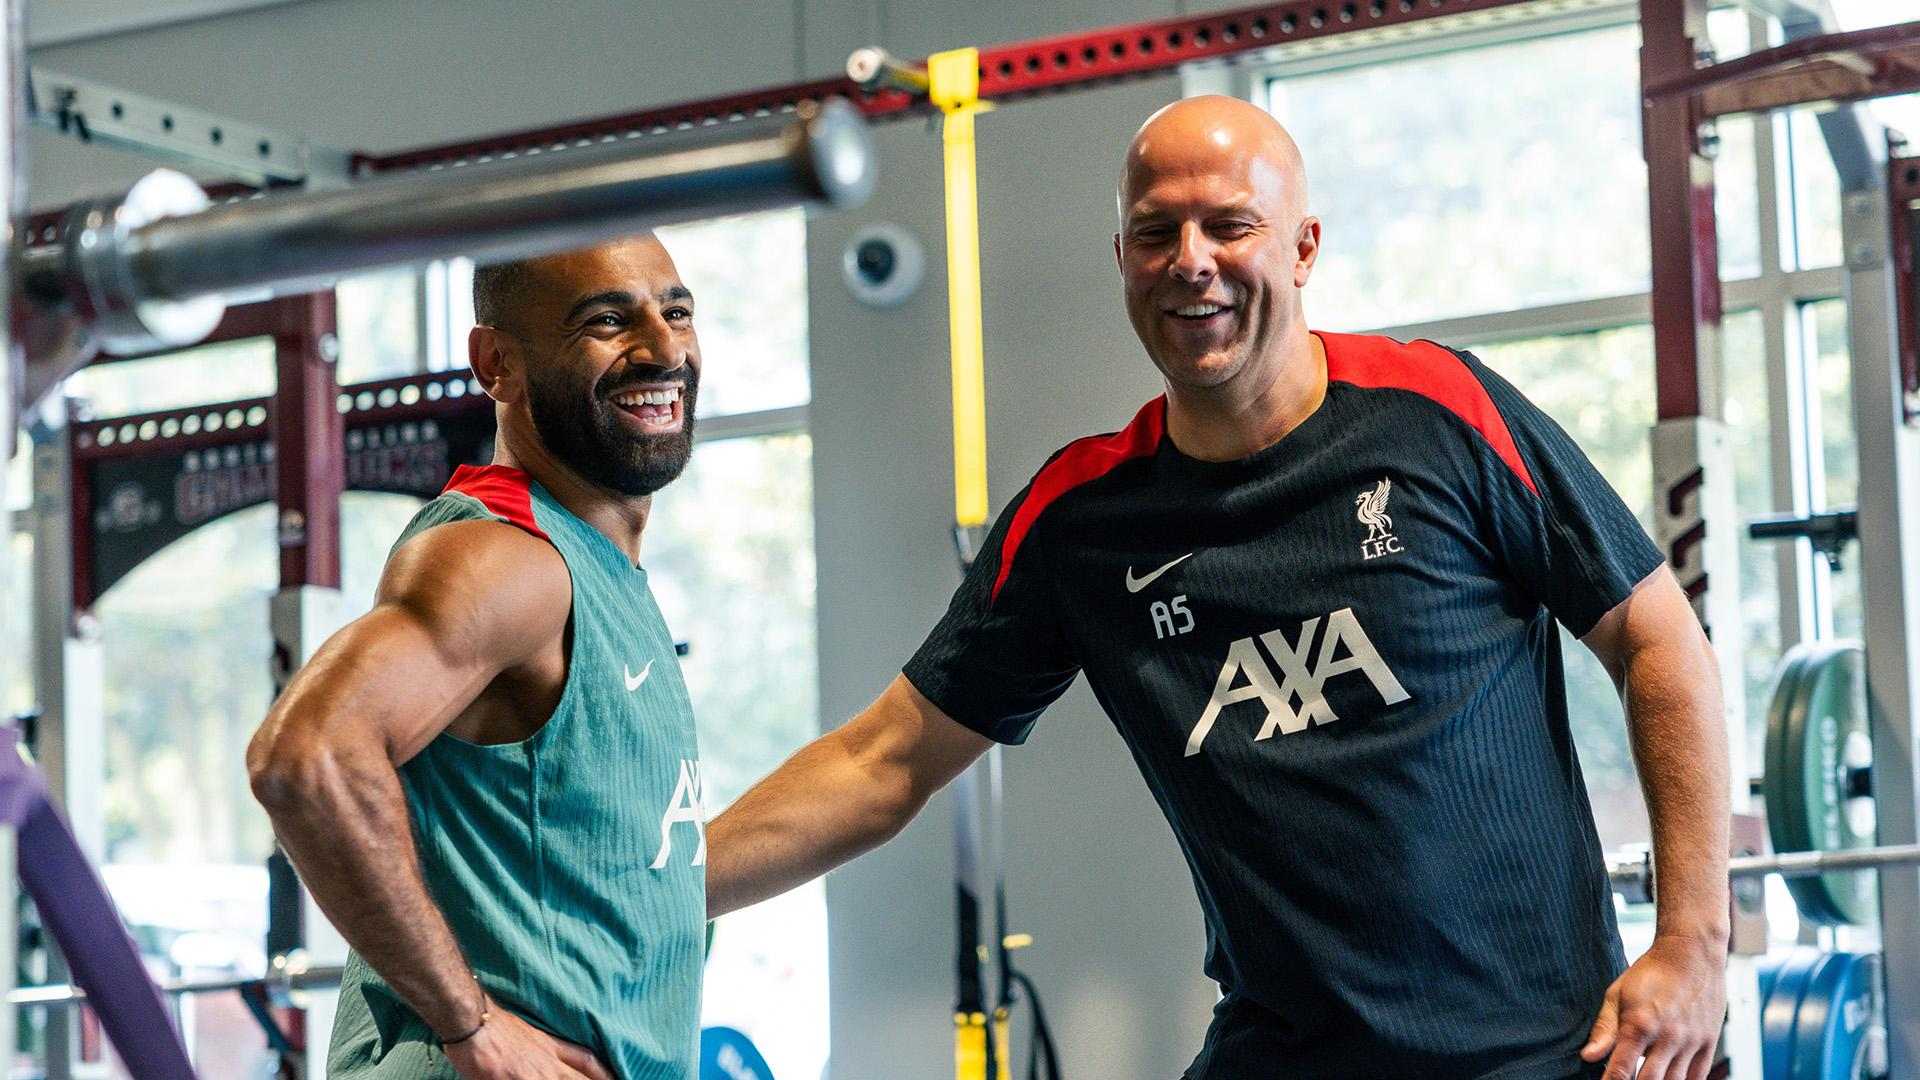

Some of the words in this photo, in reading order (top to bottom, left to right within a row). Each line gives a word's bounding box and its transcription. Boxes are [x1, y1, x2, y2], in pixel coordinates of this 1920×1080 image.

[1361, 536, 1404, 560] L.F.C.
[1150, 594, 1195, 639] AS
[1184, 607, 1412, 757] AXA
